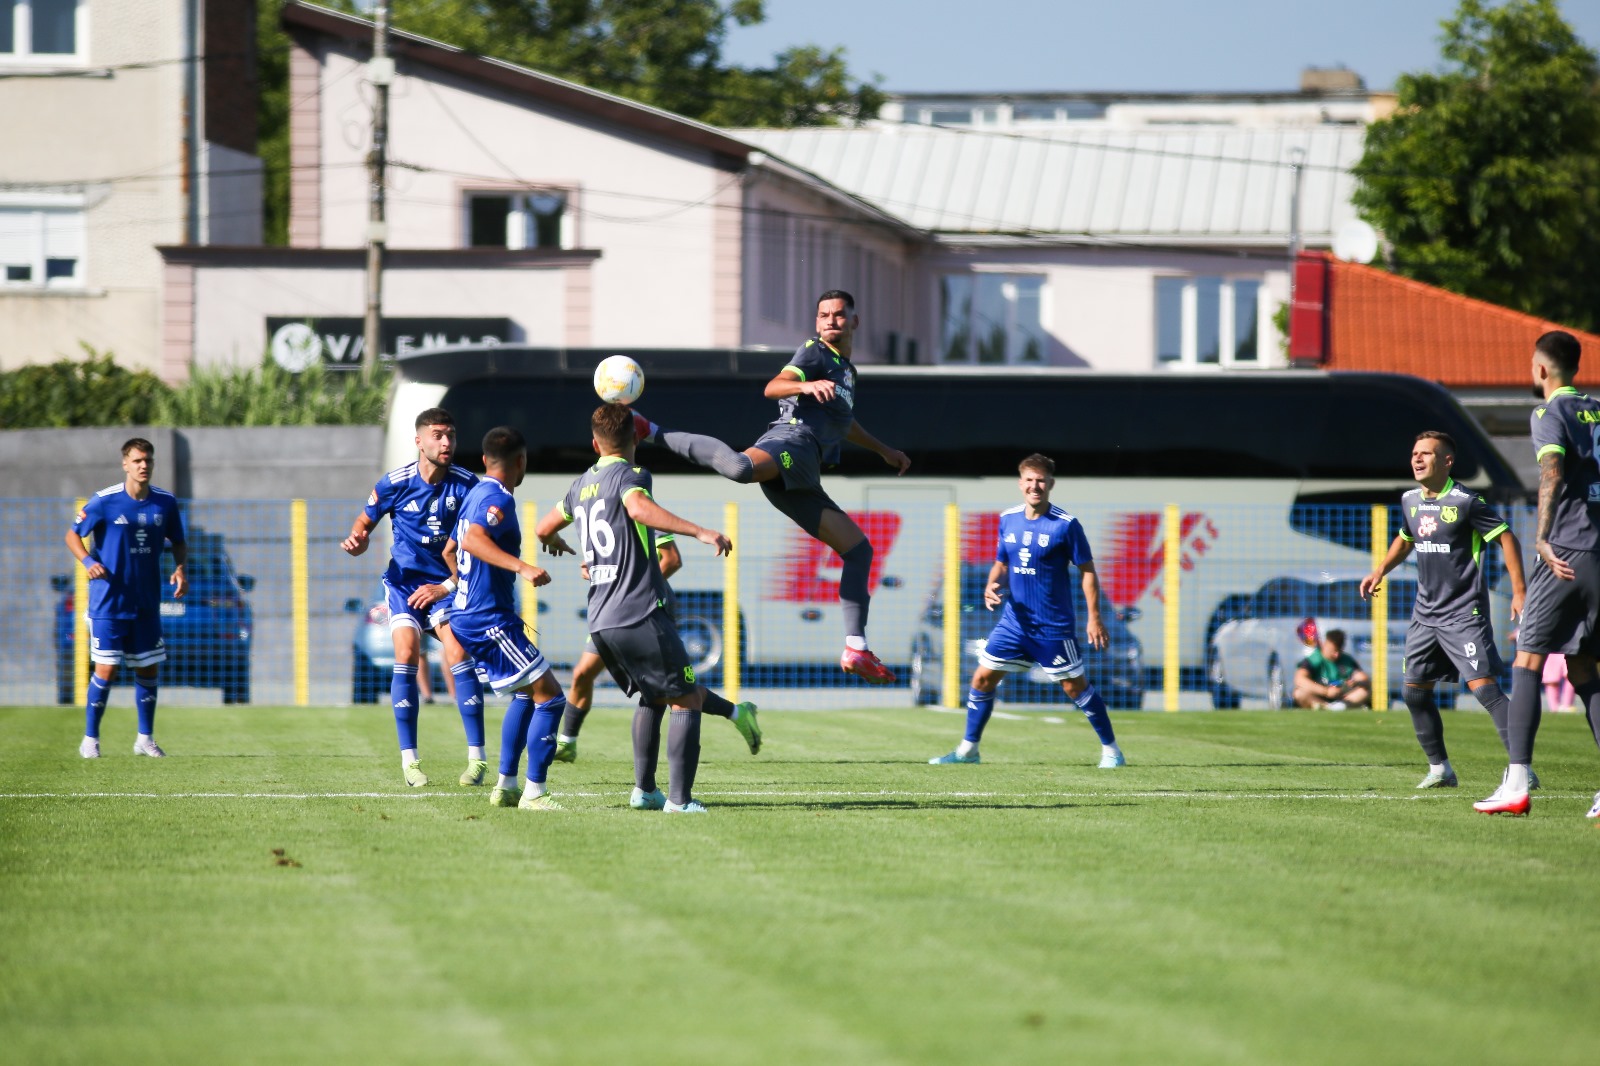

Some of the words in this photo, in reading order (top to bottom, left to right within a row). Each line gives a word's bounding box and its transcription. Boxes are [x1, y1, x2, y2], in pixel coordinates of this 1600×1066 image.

[325, 332, 500, 362] VAEM
[574, 498, 616, 563] 26
[525, 643, 538, 659] 10
[1463, 642, 1477, 658] 19
